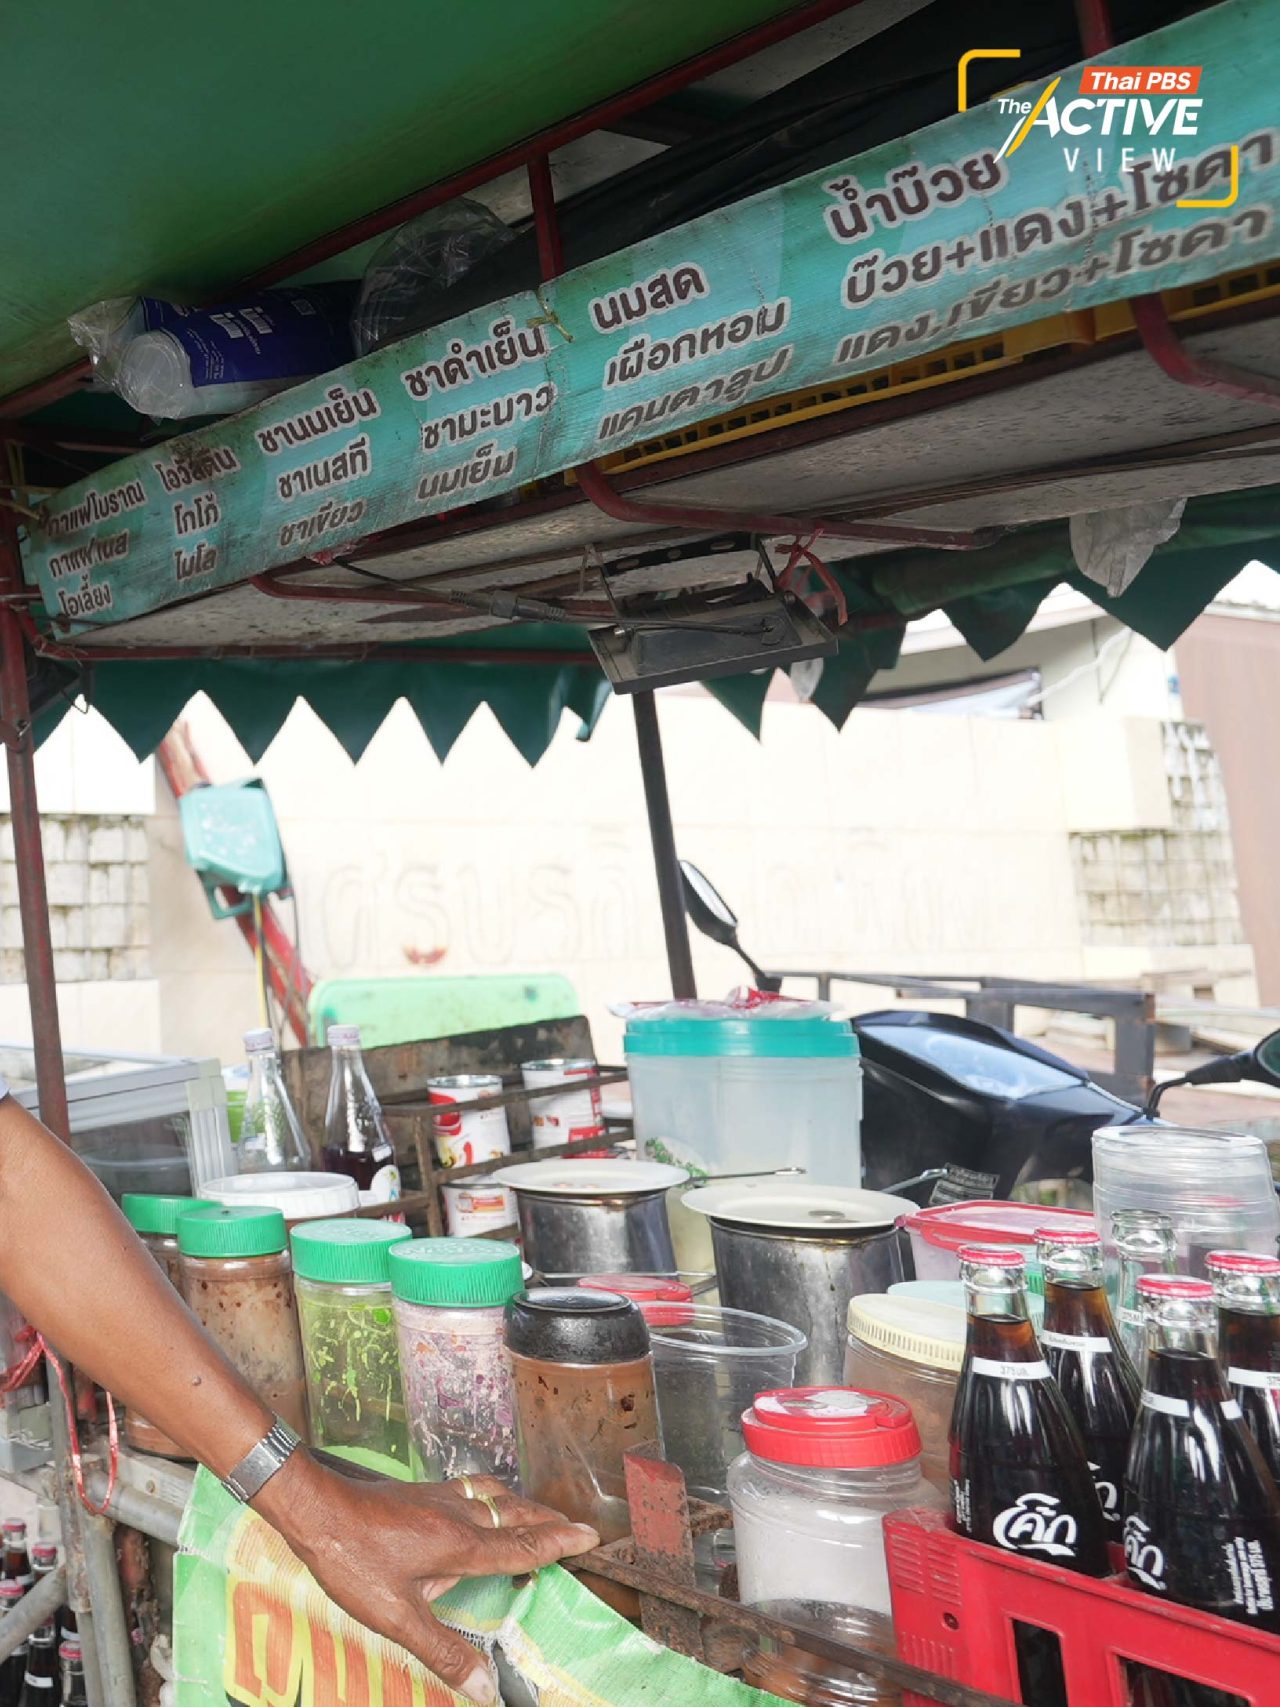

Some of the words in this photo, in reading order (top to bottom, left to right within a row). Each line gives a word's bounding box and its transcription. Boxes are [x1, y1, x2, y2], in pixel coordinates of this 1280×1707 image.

[830, 153, 1002, 239] น้ำบ๊วย
[593, 267, 706, 330] นมสด
[405, 319, 546, 397] ชาดำเย็น
[606, 302, 786, 386] เผือกหอม
[258, 387, 378, 453] ชานมเย็น
[424, 386, 555, 450] ชามะนาว
[598, 348, 790, 440] แคนตาลูป
[278, 436, 369, 498] ชาเนสที
[417, 443, 515, 499] นมเย็น
[47, 482, 146, 537] กาแฟโบราณ
[174, 492, 219, 535] โกโก้
[280, 501, 365, 546] ชาเขียว
[174, 543, 218, 581] ไมโล
[58, 574, 112, 618] โอเลี้ยง
